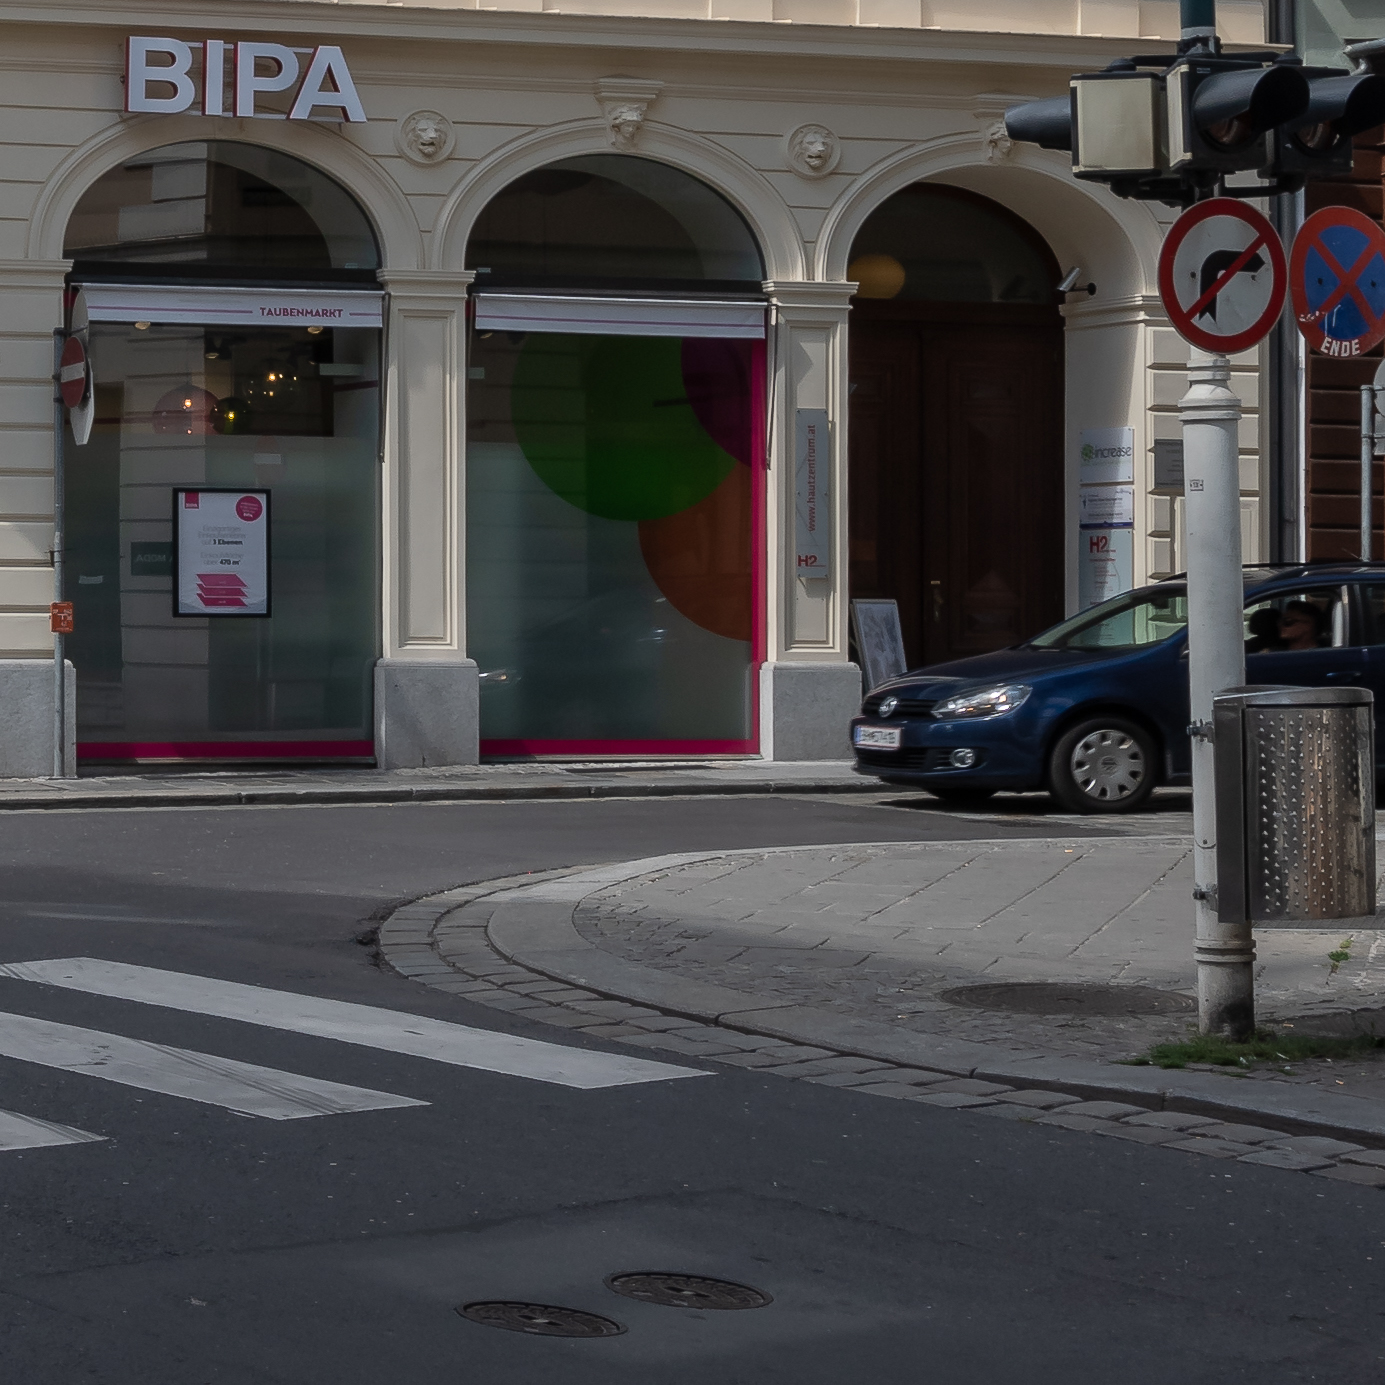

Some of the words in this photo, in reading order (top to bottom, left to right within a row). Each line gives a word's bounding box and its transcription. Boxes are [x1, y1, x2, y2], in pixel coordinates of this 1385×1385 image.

[124, 36, 368, 123] BIPA
[259, 306, 344, 318] TAUBENMARKT
[1320, 336, 1361, 357] ENDE
[807, 424, 817, 533] www.hautzentrum.at
[1089, 535, 1108, 554] H2
[219, 558, 232, 566] 470
[797, 554, 818, 567] H2
